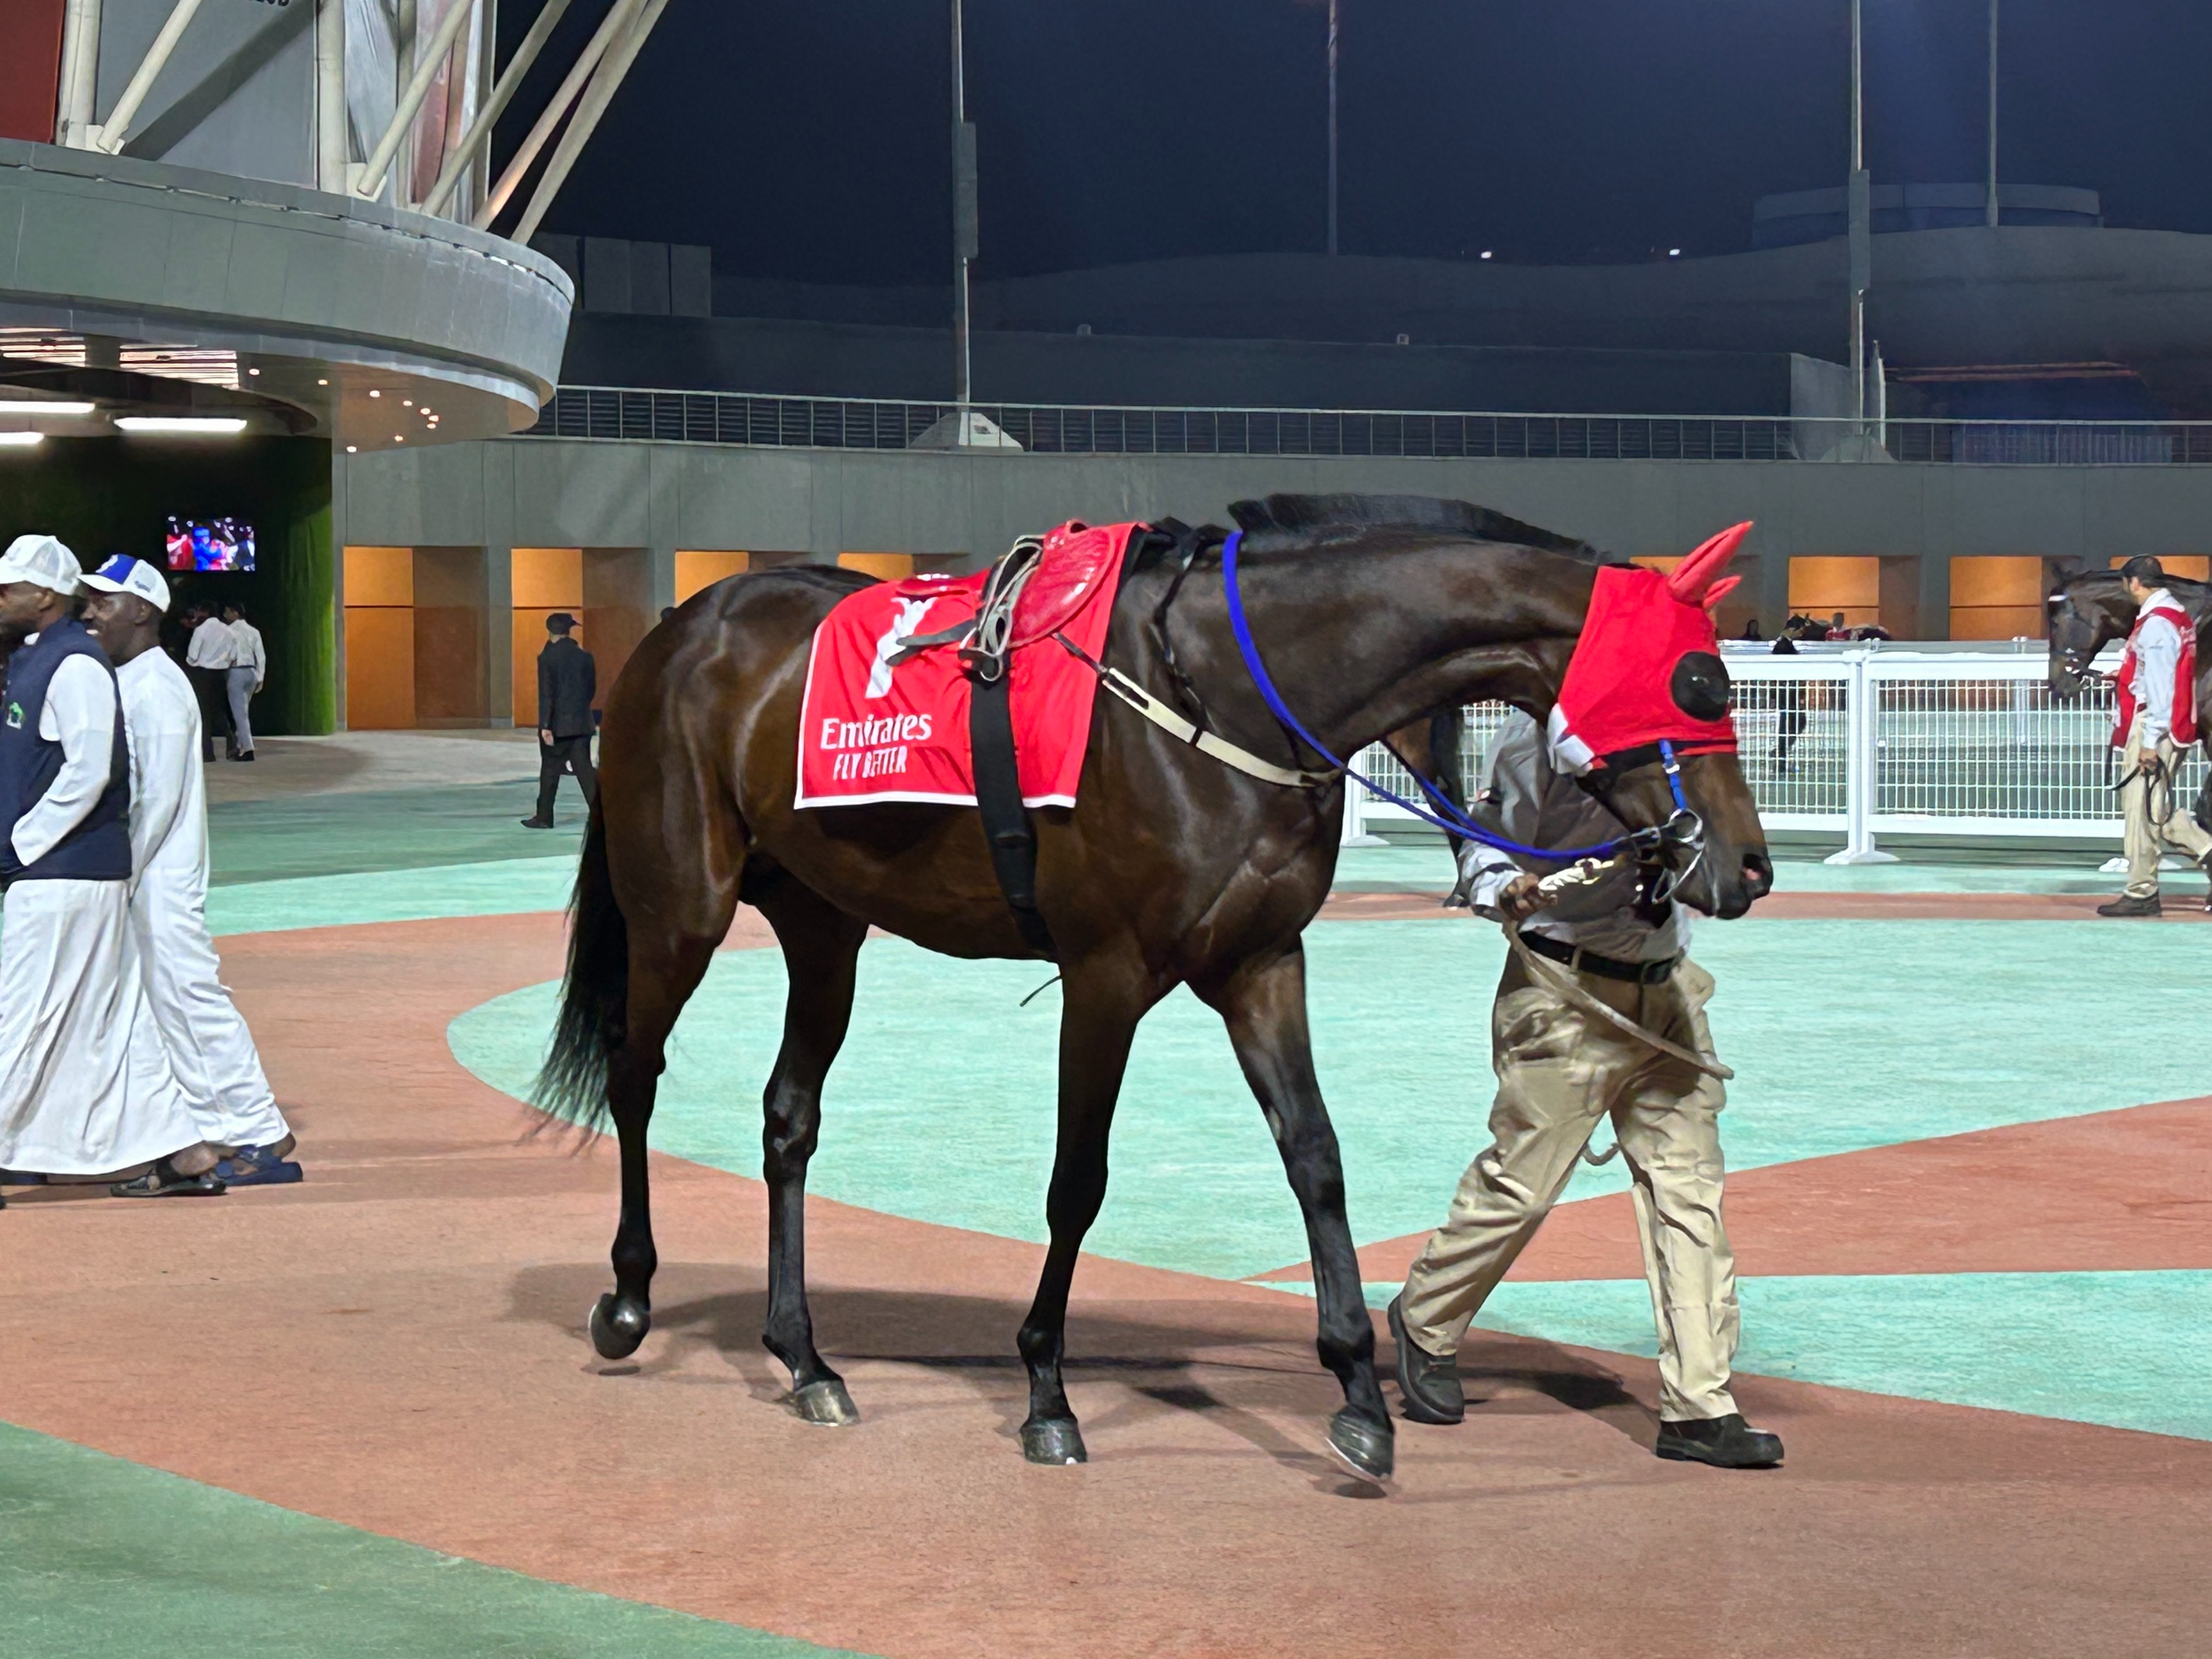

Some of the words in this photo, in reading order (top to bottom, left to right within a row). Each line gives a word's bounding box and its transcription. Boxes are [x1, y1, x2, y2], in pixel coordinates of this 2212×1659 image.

[820, 713, 932, 749] Emirates
[833, 753, 861, 780] FLY
[862, 746, 907, 778] BETTER
